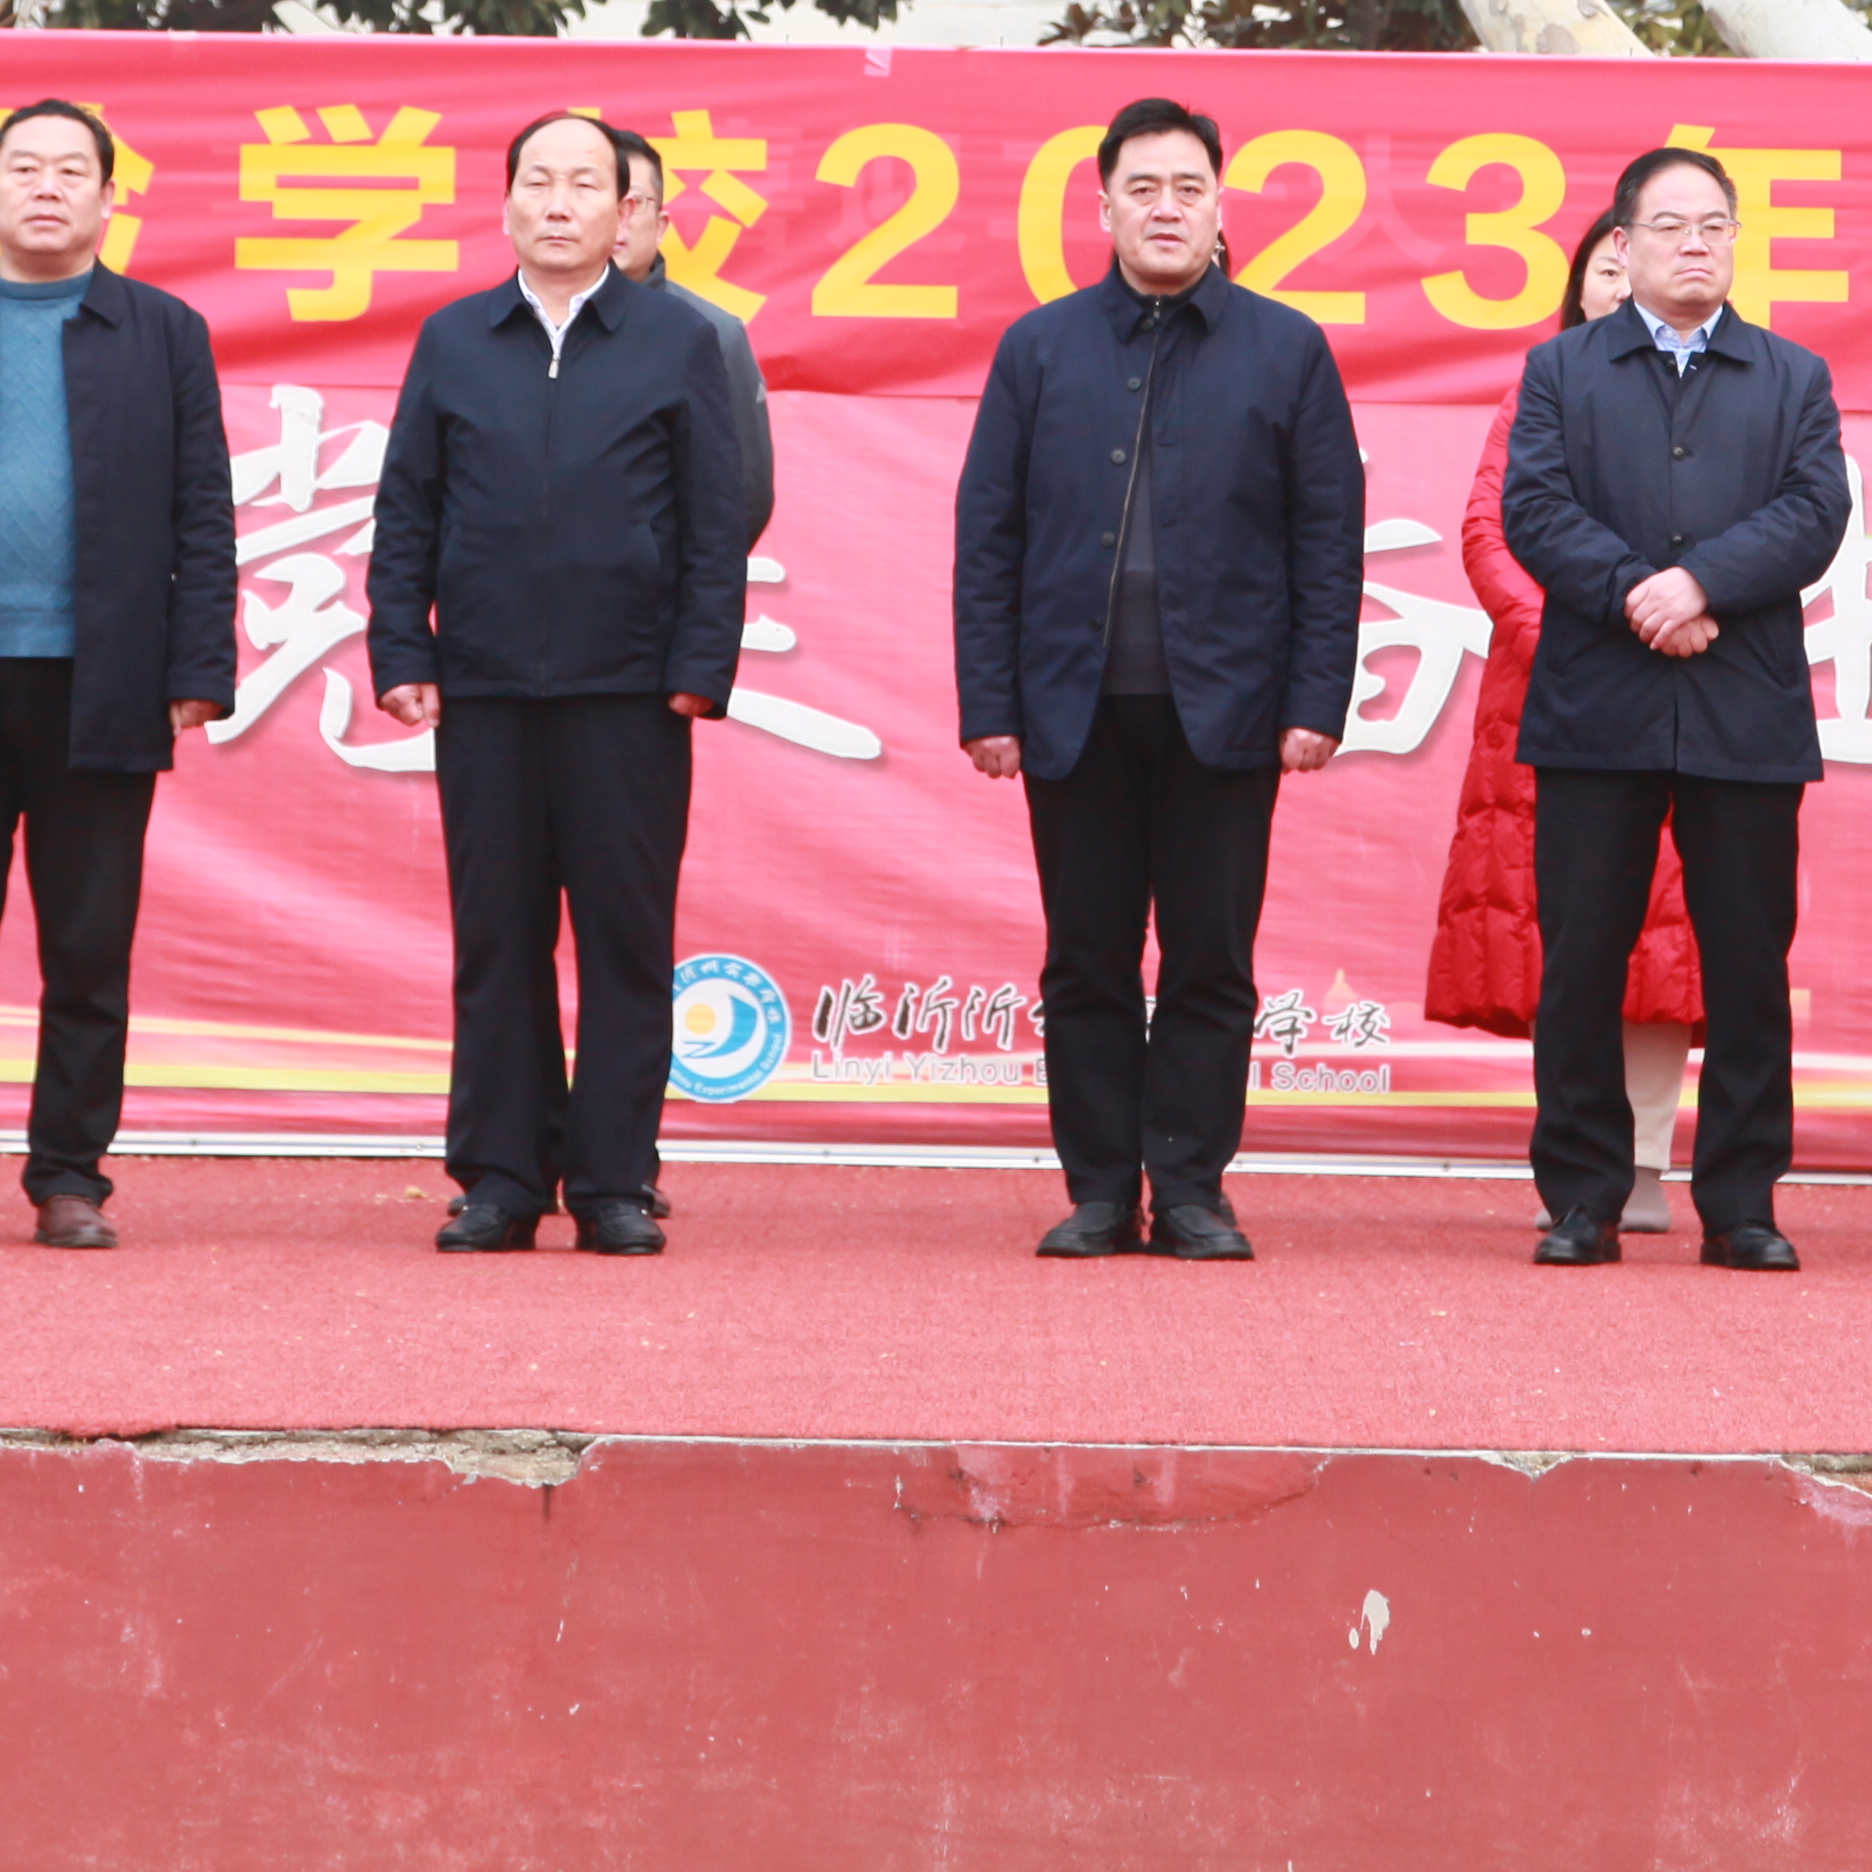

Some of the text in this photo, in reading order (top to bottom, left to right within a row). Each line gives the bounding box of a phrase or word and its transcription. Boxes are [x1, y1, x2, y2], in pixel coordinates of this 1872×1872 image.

[812, 1051, 894, 1085] Linyi
[904, 1054, 1020, 1083] Yizhou
[1273, 1061, 1390, 1093] School
